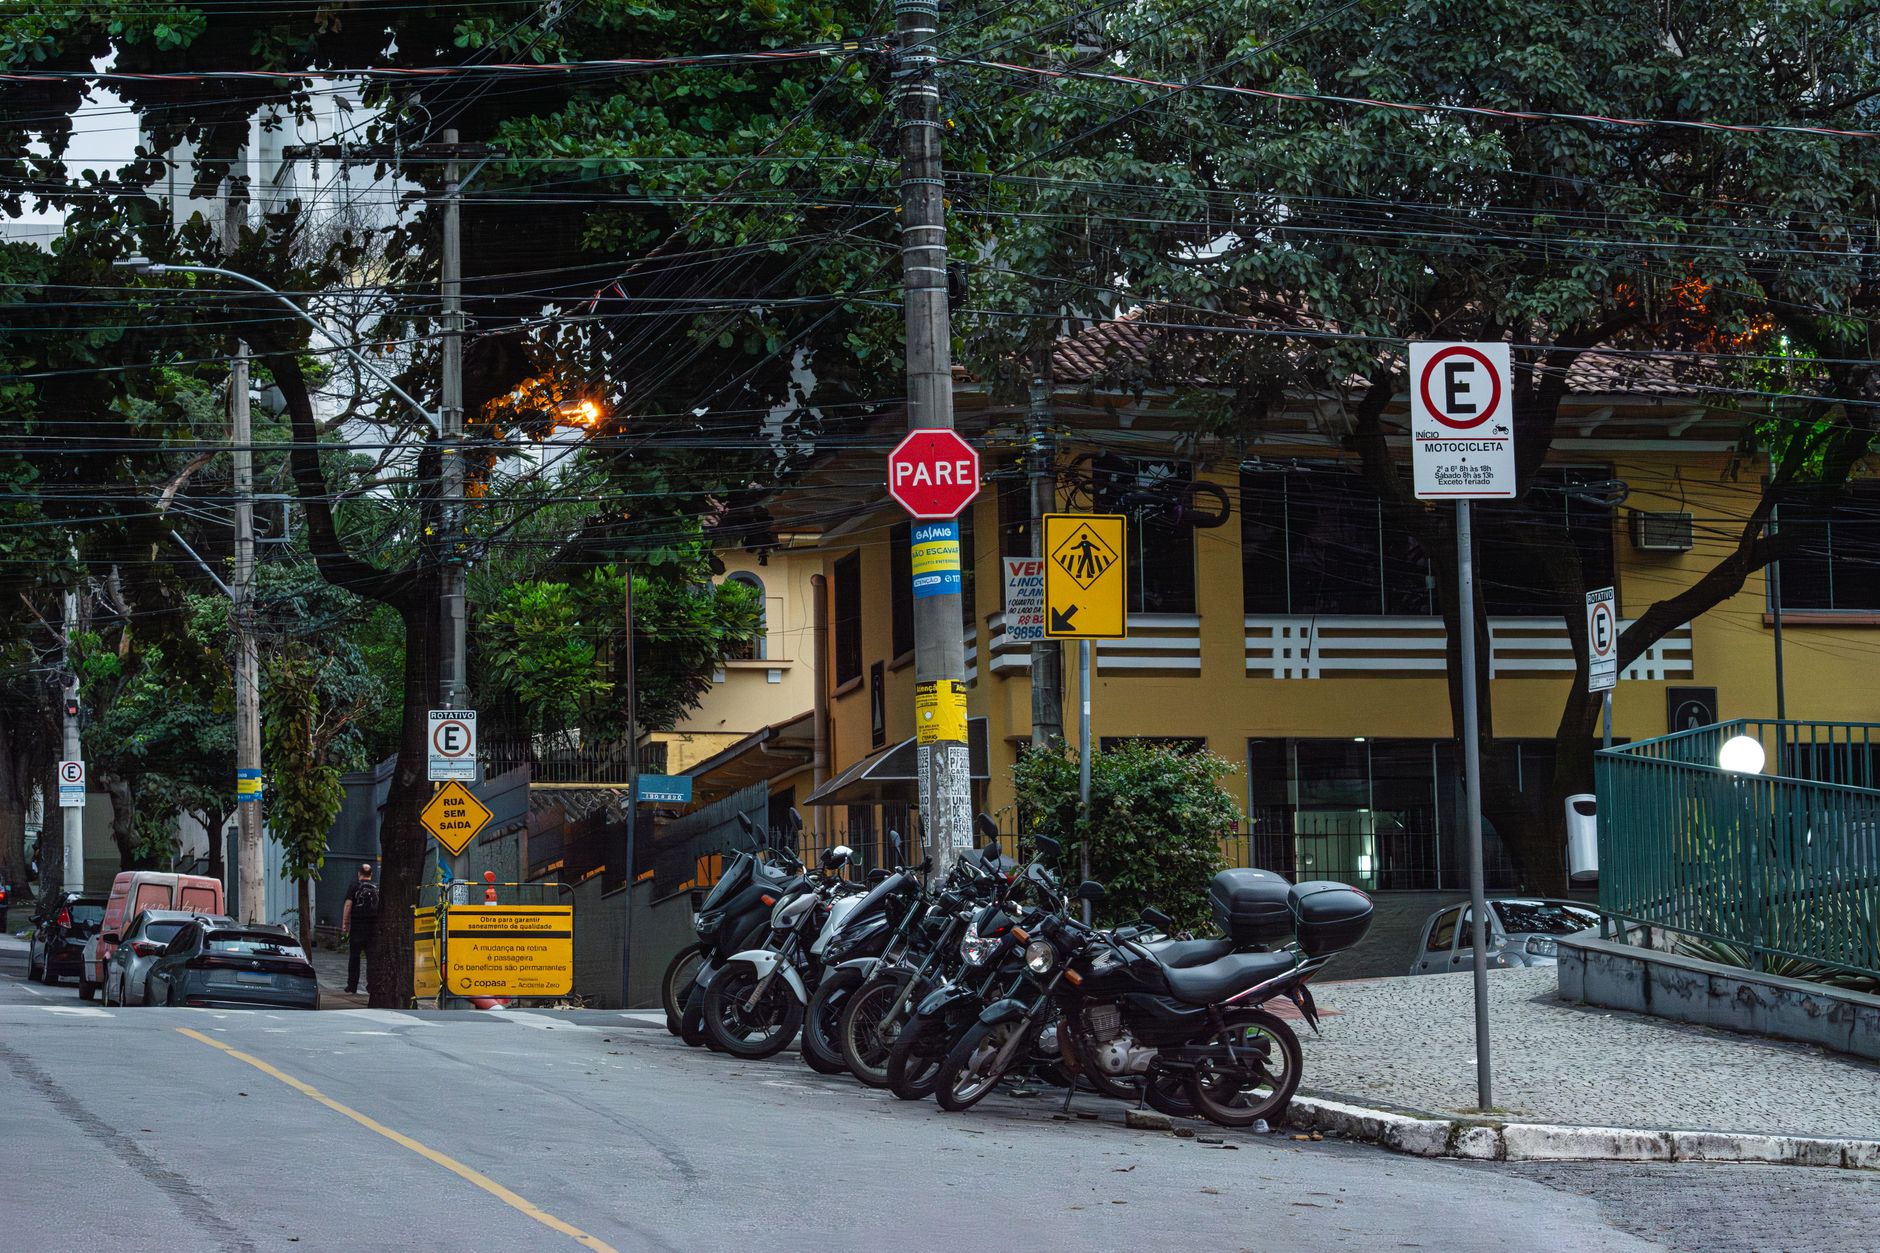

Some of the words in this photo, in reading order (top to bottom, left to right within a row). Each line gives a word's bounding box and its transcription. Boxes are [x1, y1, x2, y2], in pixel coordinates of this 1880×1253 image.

[1444, 362, 1476, 414] E
[1416, 430, 1440, 439] INÍCIO
[1425, 442, 1504, 452] MOTOCICLETA
[896, 461, 972, 486] PARE
[1588, 590, 1613, 602] ROTATIVO
[1013, 626, 1043, 639] 9856
[1597, 613, 1606, 648] E
[445, 727, 459, 750] E
[68, 766, 76, 778] E
[443, 798, 465, 806] RUA
[440, 820, 471, 830] SAÍDA
[480, 944, 513, 952] mudança
[474, 980, 506, 988] copasa
